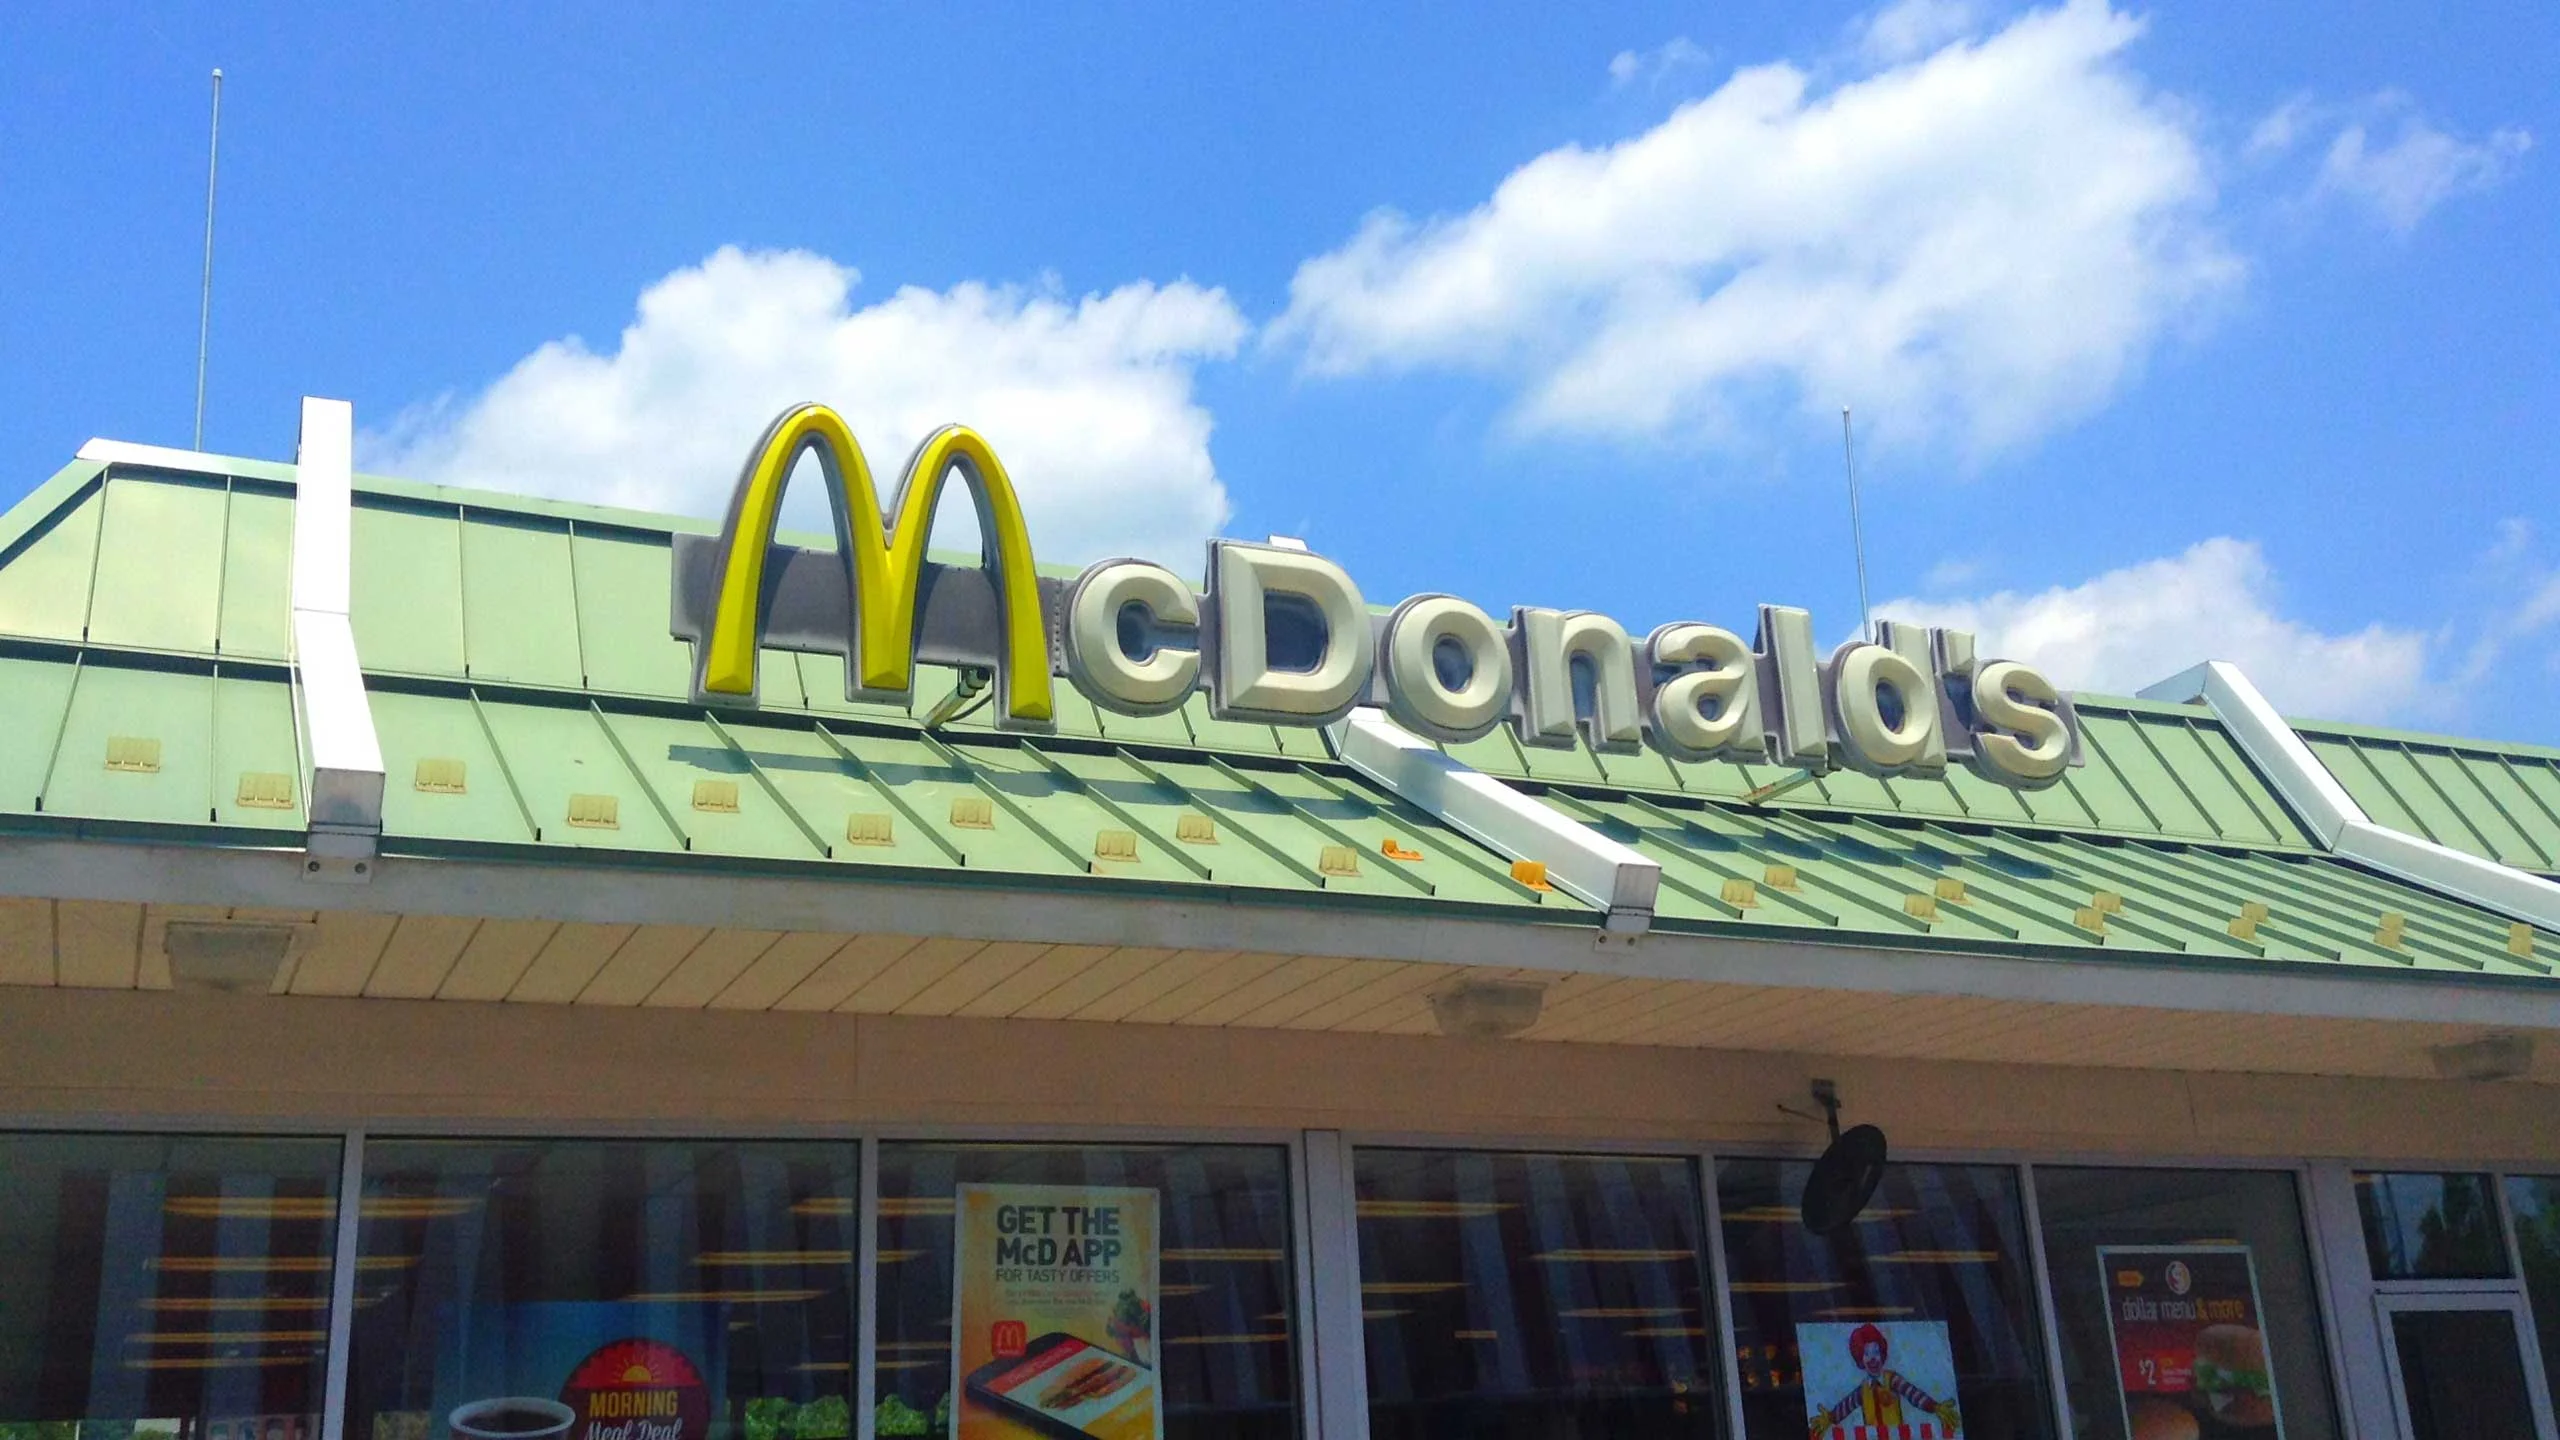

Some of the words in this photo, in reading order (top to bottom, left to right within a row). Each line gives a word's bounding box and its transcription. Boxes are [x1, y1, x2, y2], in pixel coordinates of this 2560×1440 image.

[703, 402, 2076, 788] McDonald's
[996, 1205, 1056, 1235] GET
[1062, 1206, 1121, 1236] THE
[996, 1238, 1058, 1266] McD
[1062, 1239, 1122, 1267] APP
[995, 1269, 1023, 1283] FOR
[1027, 1269, 1066, 1283] TASTY
[1069, 1269, 1121, 1284] OFFERS
[2122, 1297, 2158, 1321] dollar
[2161, 1300, 2197, 1321] menu
[2209, 1300, 2245, 1320] more
[589, 1390, 680, 1418] MORNING
[583, 1418, 634, 1440] Meal
[635, 1417, 684, 1440] Deal
